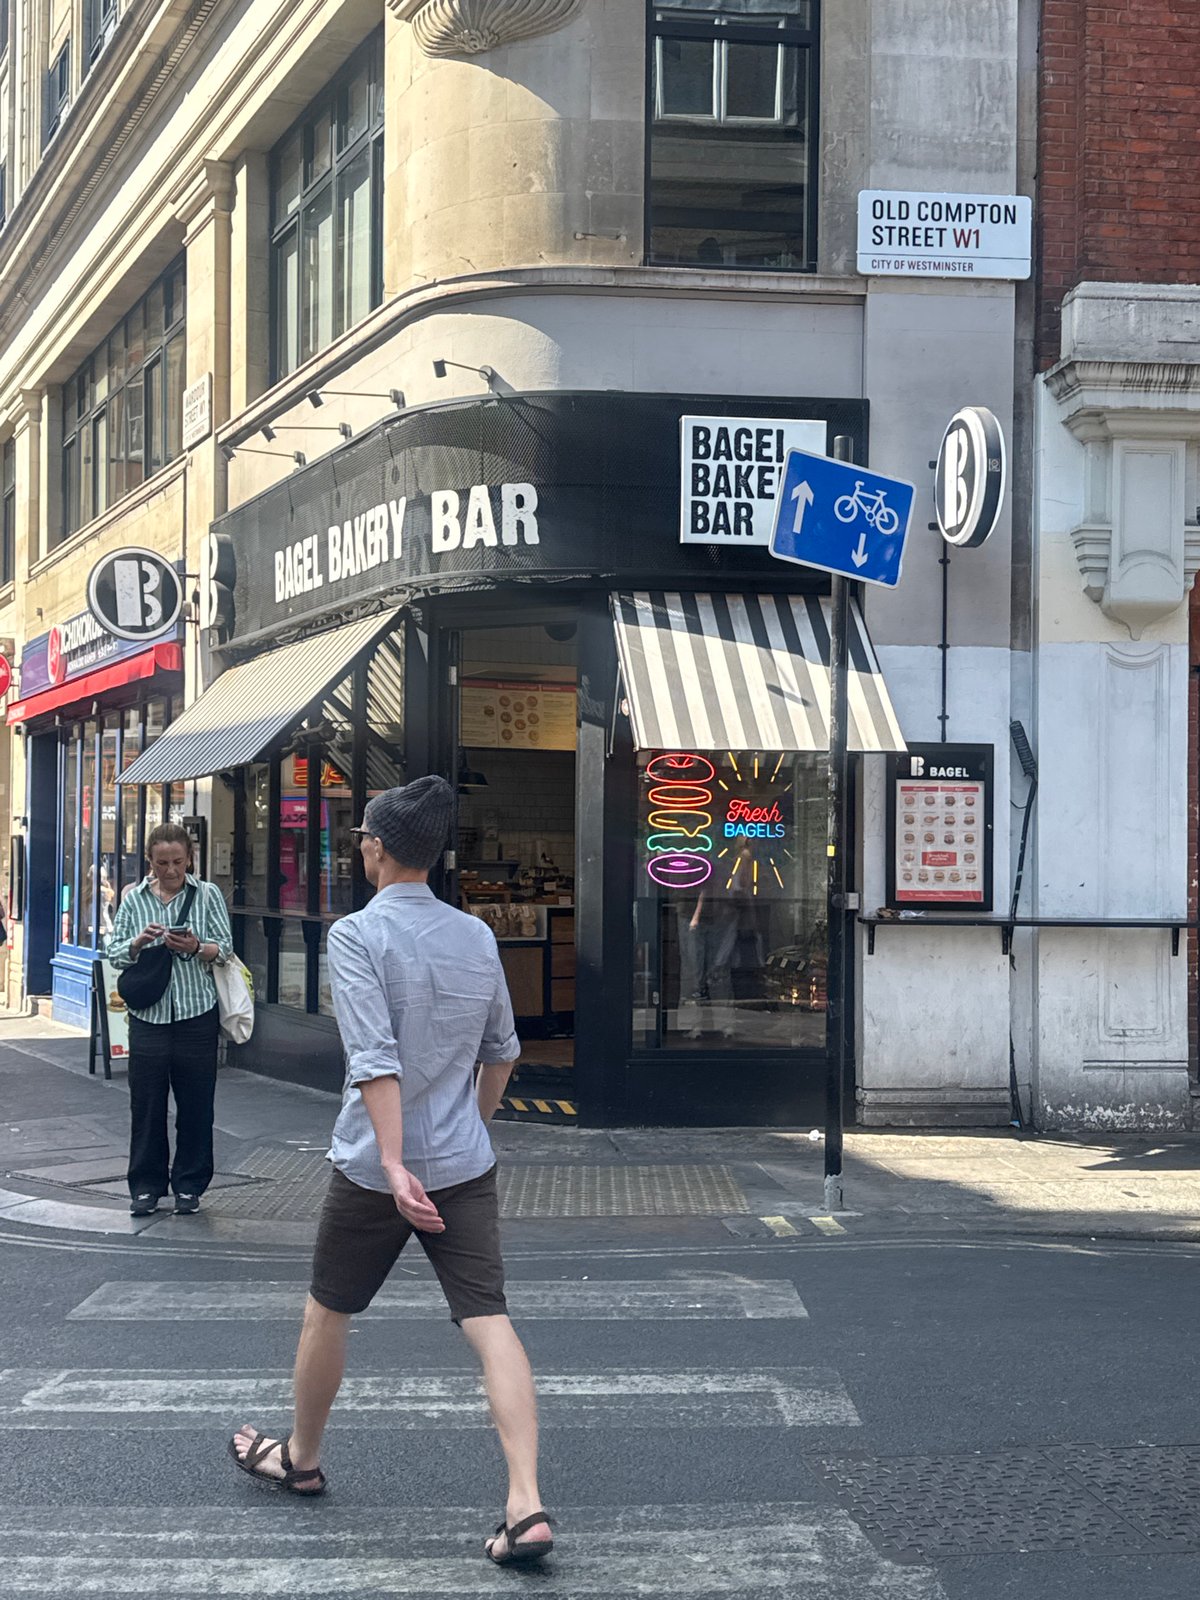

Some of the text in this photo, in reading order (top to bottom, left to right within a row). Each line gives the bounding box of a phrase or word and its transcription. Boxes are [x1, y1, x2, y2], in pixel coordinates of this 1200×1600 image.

[872, 199, 1017, 225] OLD COMPTON
[872, 225, 980, 249] STREET W1
[871, 259, 974, 272] CITY OF WESTMINSTER
[691, 464, 783, 500] BAKE
[690, 501, 754, 536] BAR
[274, 482, 540, 604] BAGEL BAKERY BAR
[114, 560, 162, 627] B
[929, 766, 970, 778] BAGEL
[726, 799, 784, 822] Fresh
[724, 822, 785, 838] BAGELS
